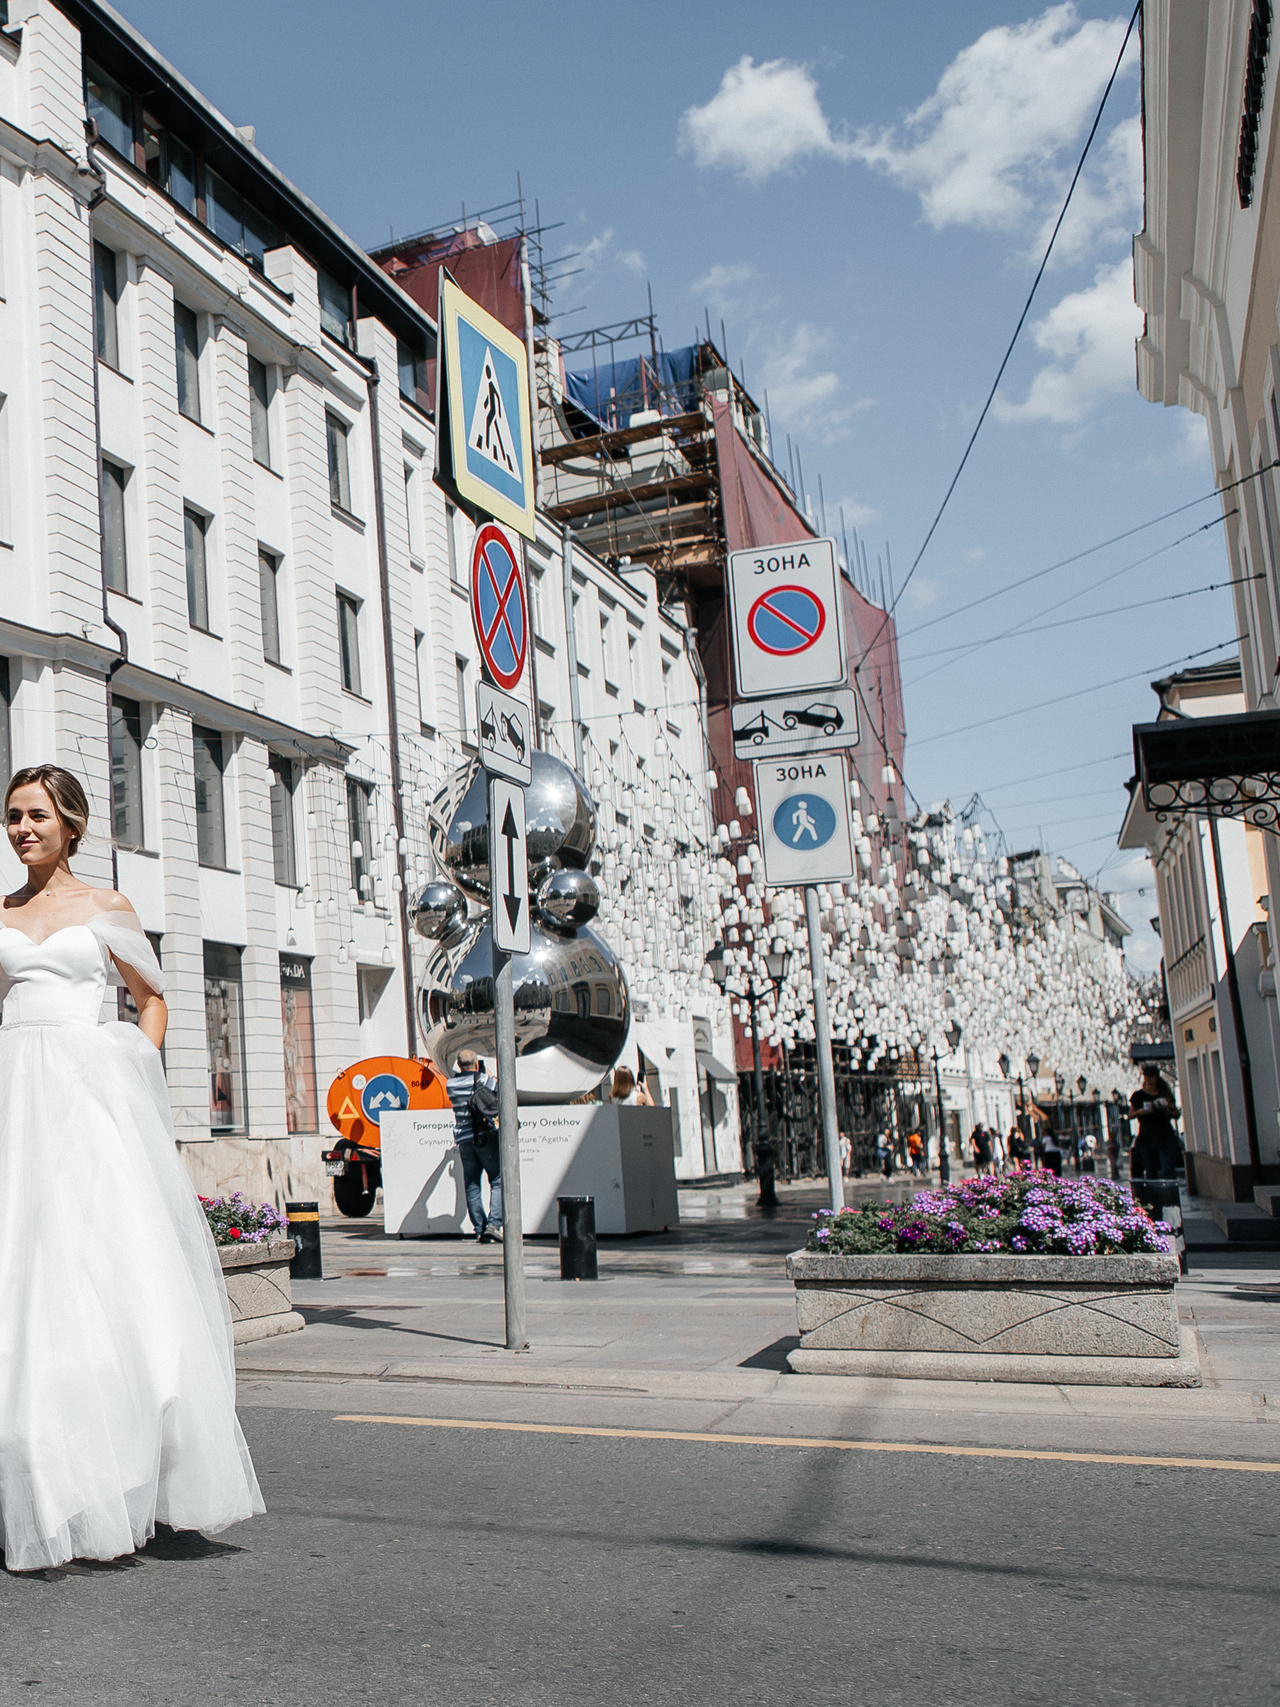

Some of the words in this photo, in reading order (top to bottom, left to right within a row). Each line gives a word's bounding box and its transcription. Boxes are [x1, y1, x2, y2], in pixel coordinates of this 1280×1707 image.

[753, 553, 811, 575] ЗОНА
[776, 764, 827, 781] ЗОНА
[413, 1121, 455, 1131] Григорий
[540, 1117, 581, 1127] Orekhov
